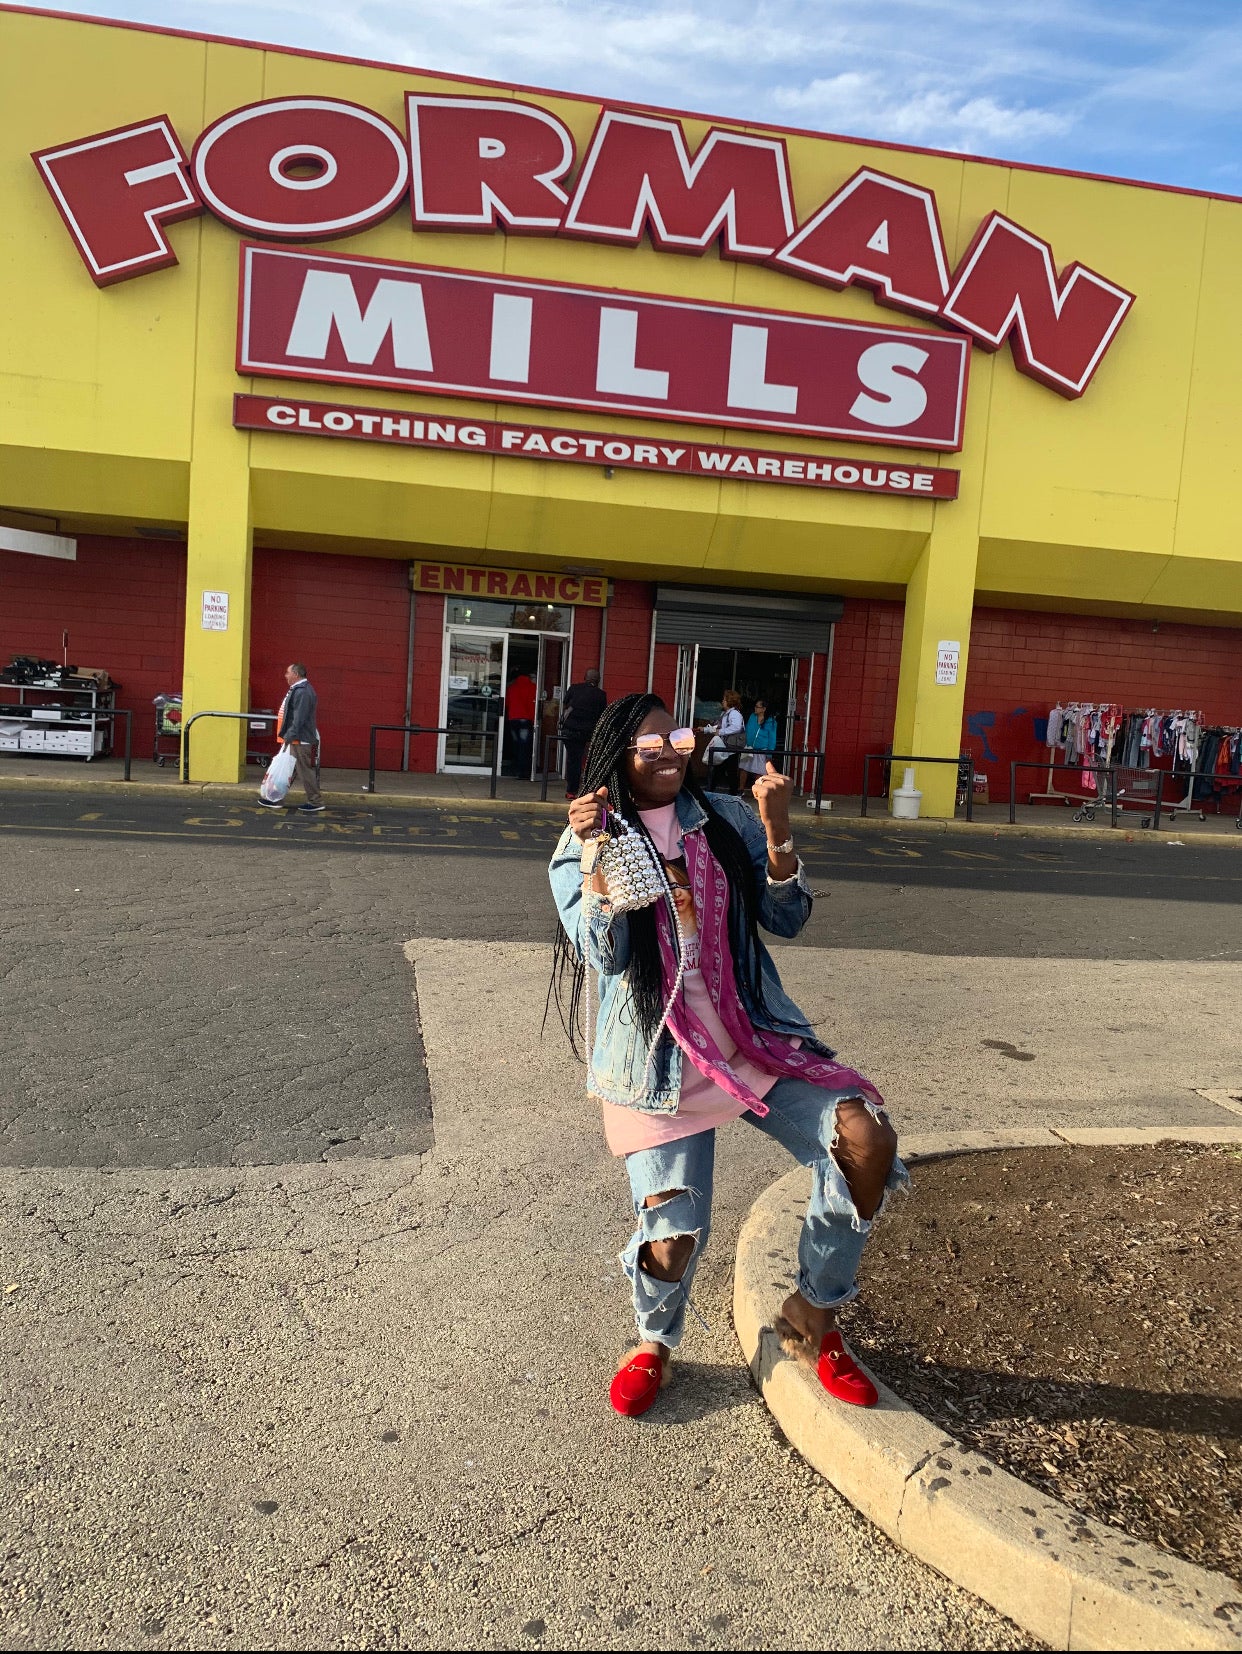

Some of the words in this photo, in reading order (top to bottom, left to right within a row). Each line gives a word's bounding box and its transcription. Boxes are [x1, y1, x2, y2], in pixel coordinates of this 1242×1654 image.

[32, 91, 1136, 399] FORMAN
[285, 269, 929, 427] MILLS
[266, 405, 487, 446] CLOTHING
[501, 430, 687, 467] FACTORY
[698, 451, 934, 491] WAREHOUSE
[204, 604, 227, 613] PARKING
[210, 595, 221, 604] NO
[420, 565, 603, 603] ENTRANCE
